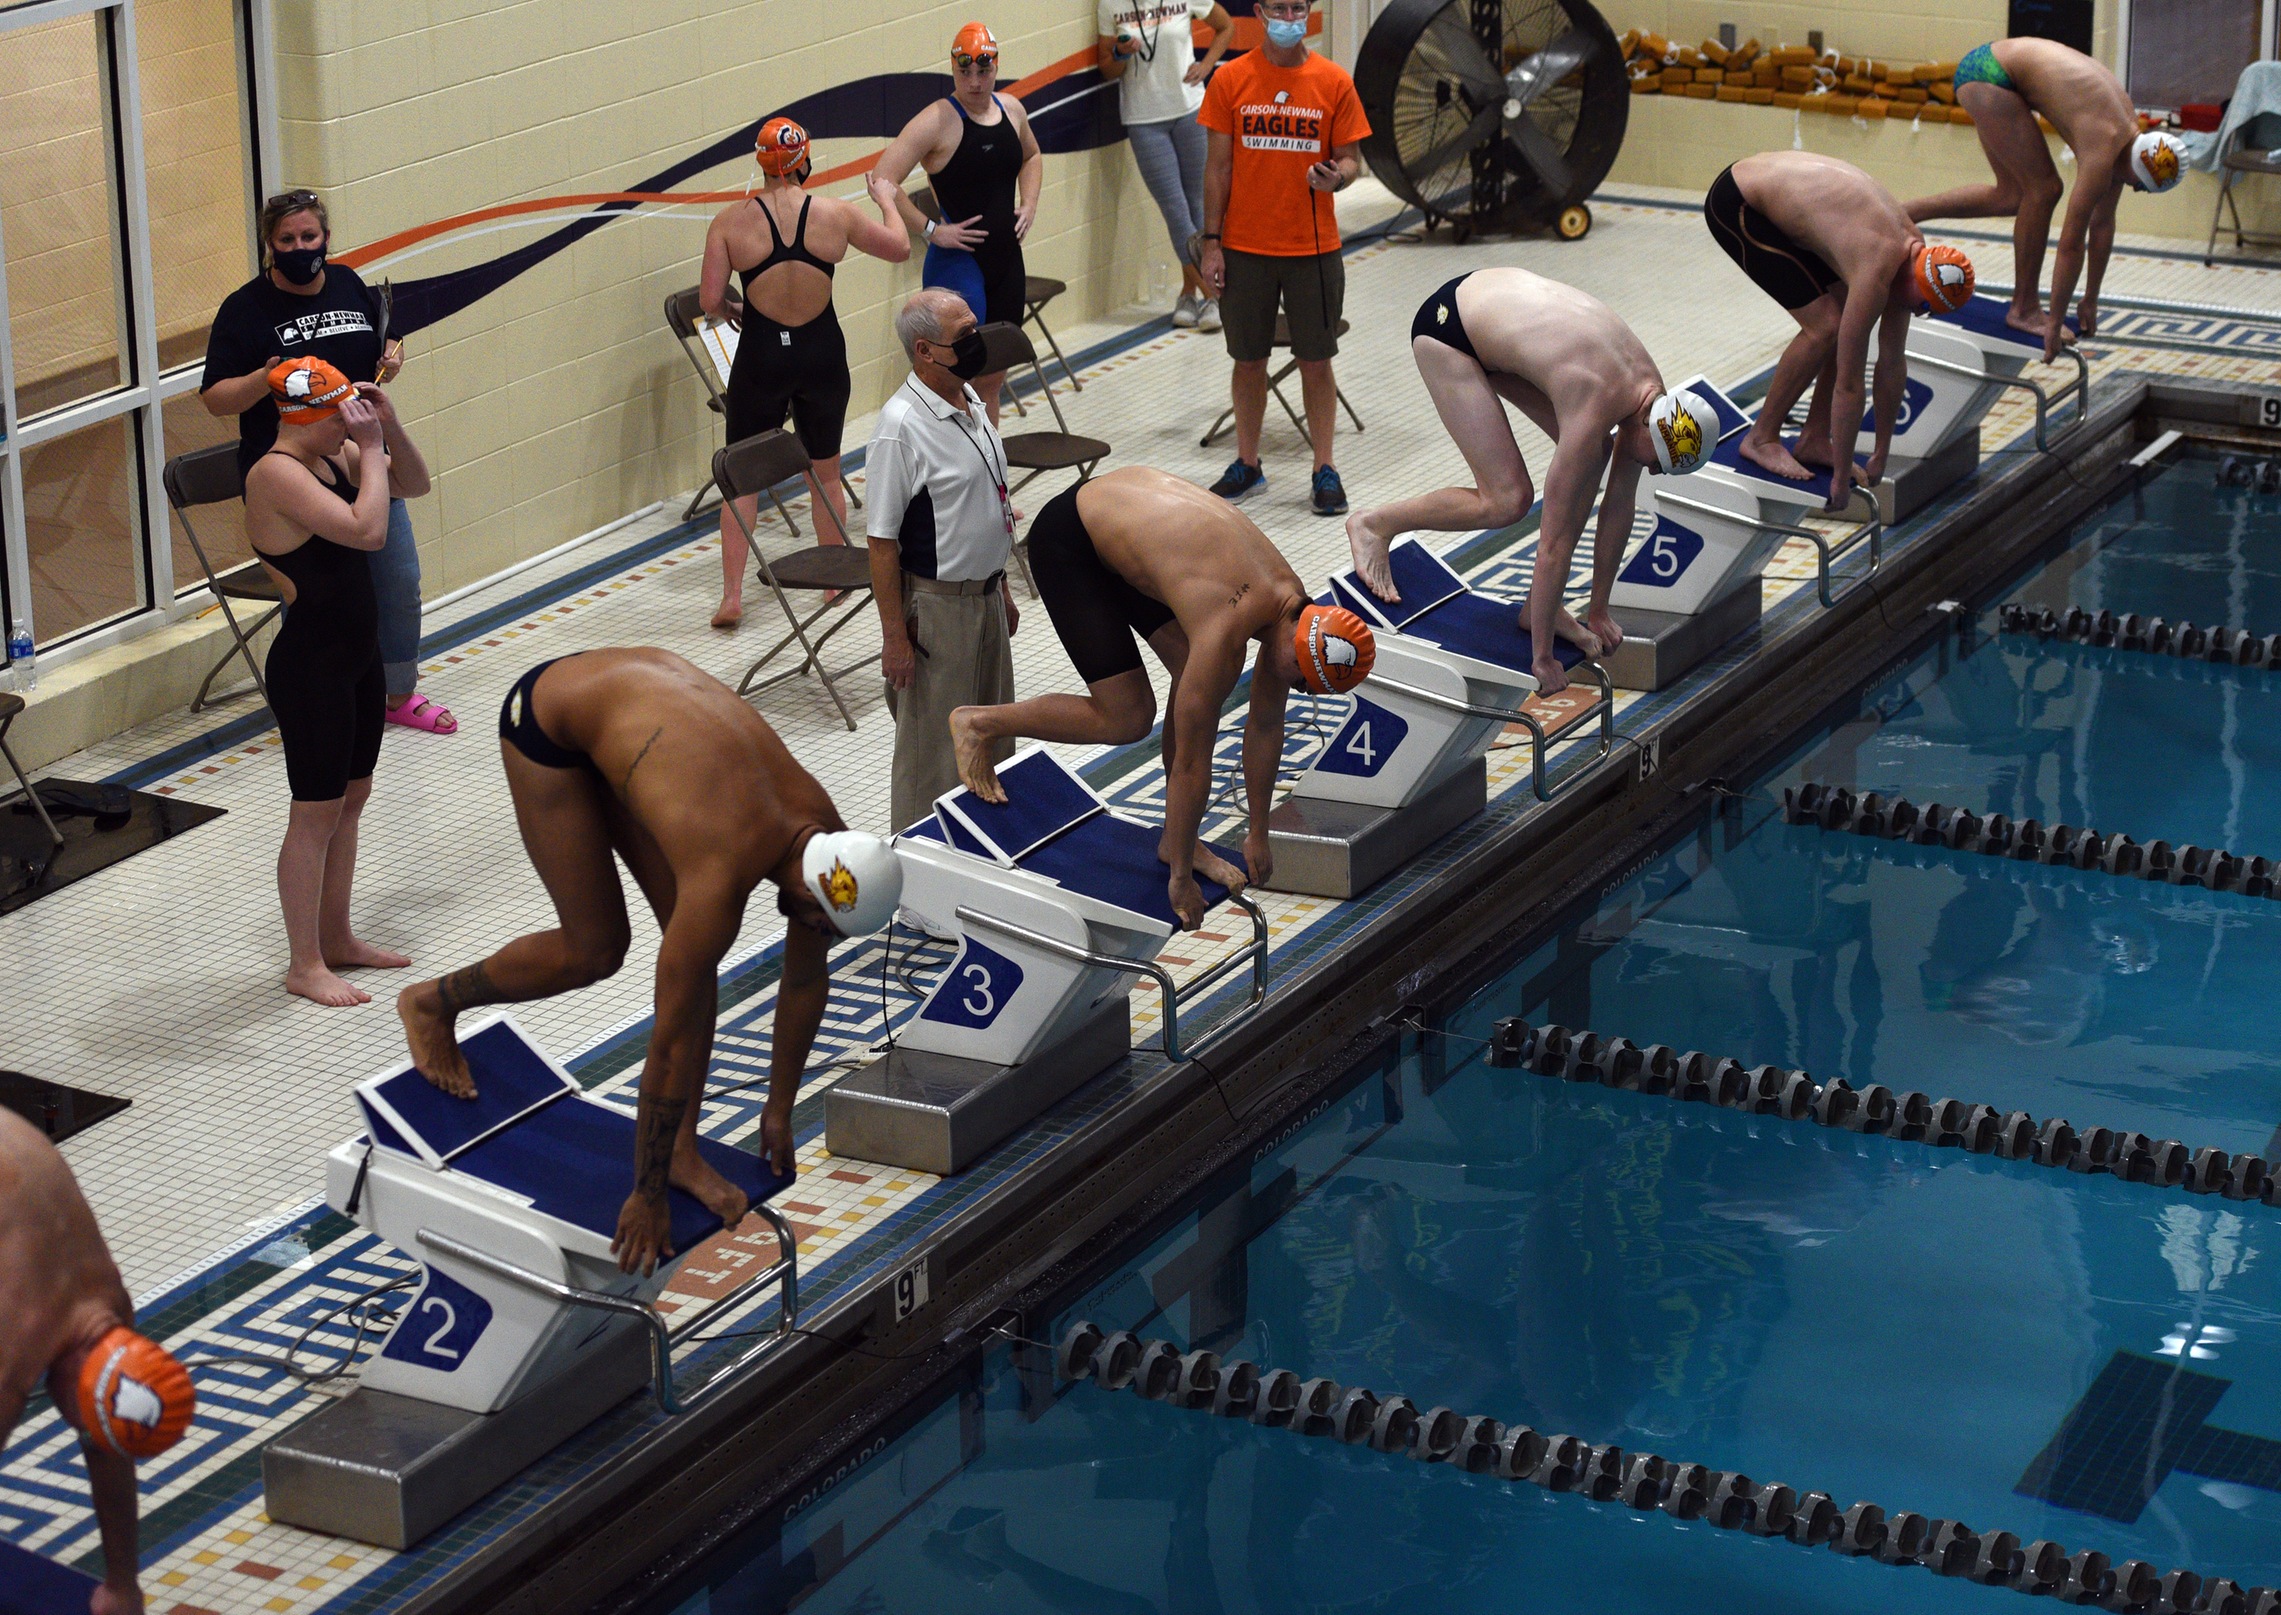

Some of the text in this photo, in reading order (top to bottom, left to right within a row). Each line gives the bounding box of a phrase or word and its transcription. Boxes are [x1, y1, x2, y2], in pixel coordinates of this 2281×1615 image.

[1240, 104, 1323, 119] CARSON-NEWMAN
[1243, 115, 1320, 139] EAGLES
[1246, 137, 1313, 151] SWIMMING
[2264, 398, 2281, 426] 9
[1651, 535, 1678, 577] 5
[1346, 720, 1376, 766] 4
[1641, 744, 1651, 778] 9
[962, 963, 994, 1016] 3
[898, 1270, 915, 1316] 9
[422, 1296, 459, 1359] 2
